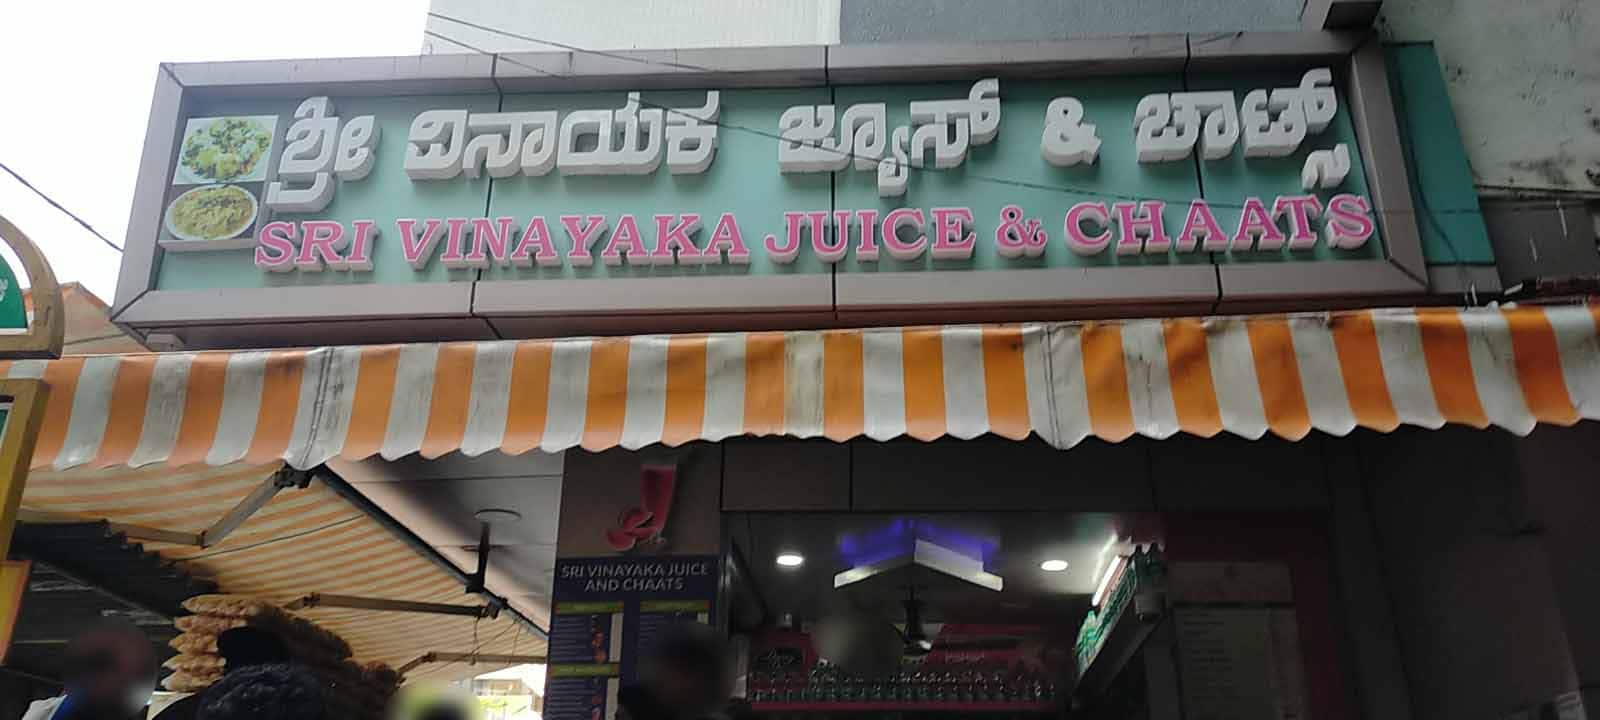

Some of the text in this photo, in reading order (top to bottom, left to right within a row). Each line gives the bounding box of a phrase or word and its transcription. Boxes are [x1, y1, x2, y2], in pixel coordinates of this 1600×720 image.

[267, 68, 1350, 212] ಶ್ರೀ ವಿನಾಯಕ ಜ್ಯೂಸ್ & ಚಾಟ್ಸ್
[254, 194, 1375, 272] SRI VINAYAKA JUICE & CHAATS
[561, 562, 709, 578] SRI VINAYAKA JUICE
[584, 577, 684, 592] AND CHAATS
